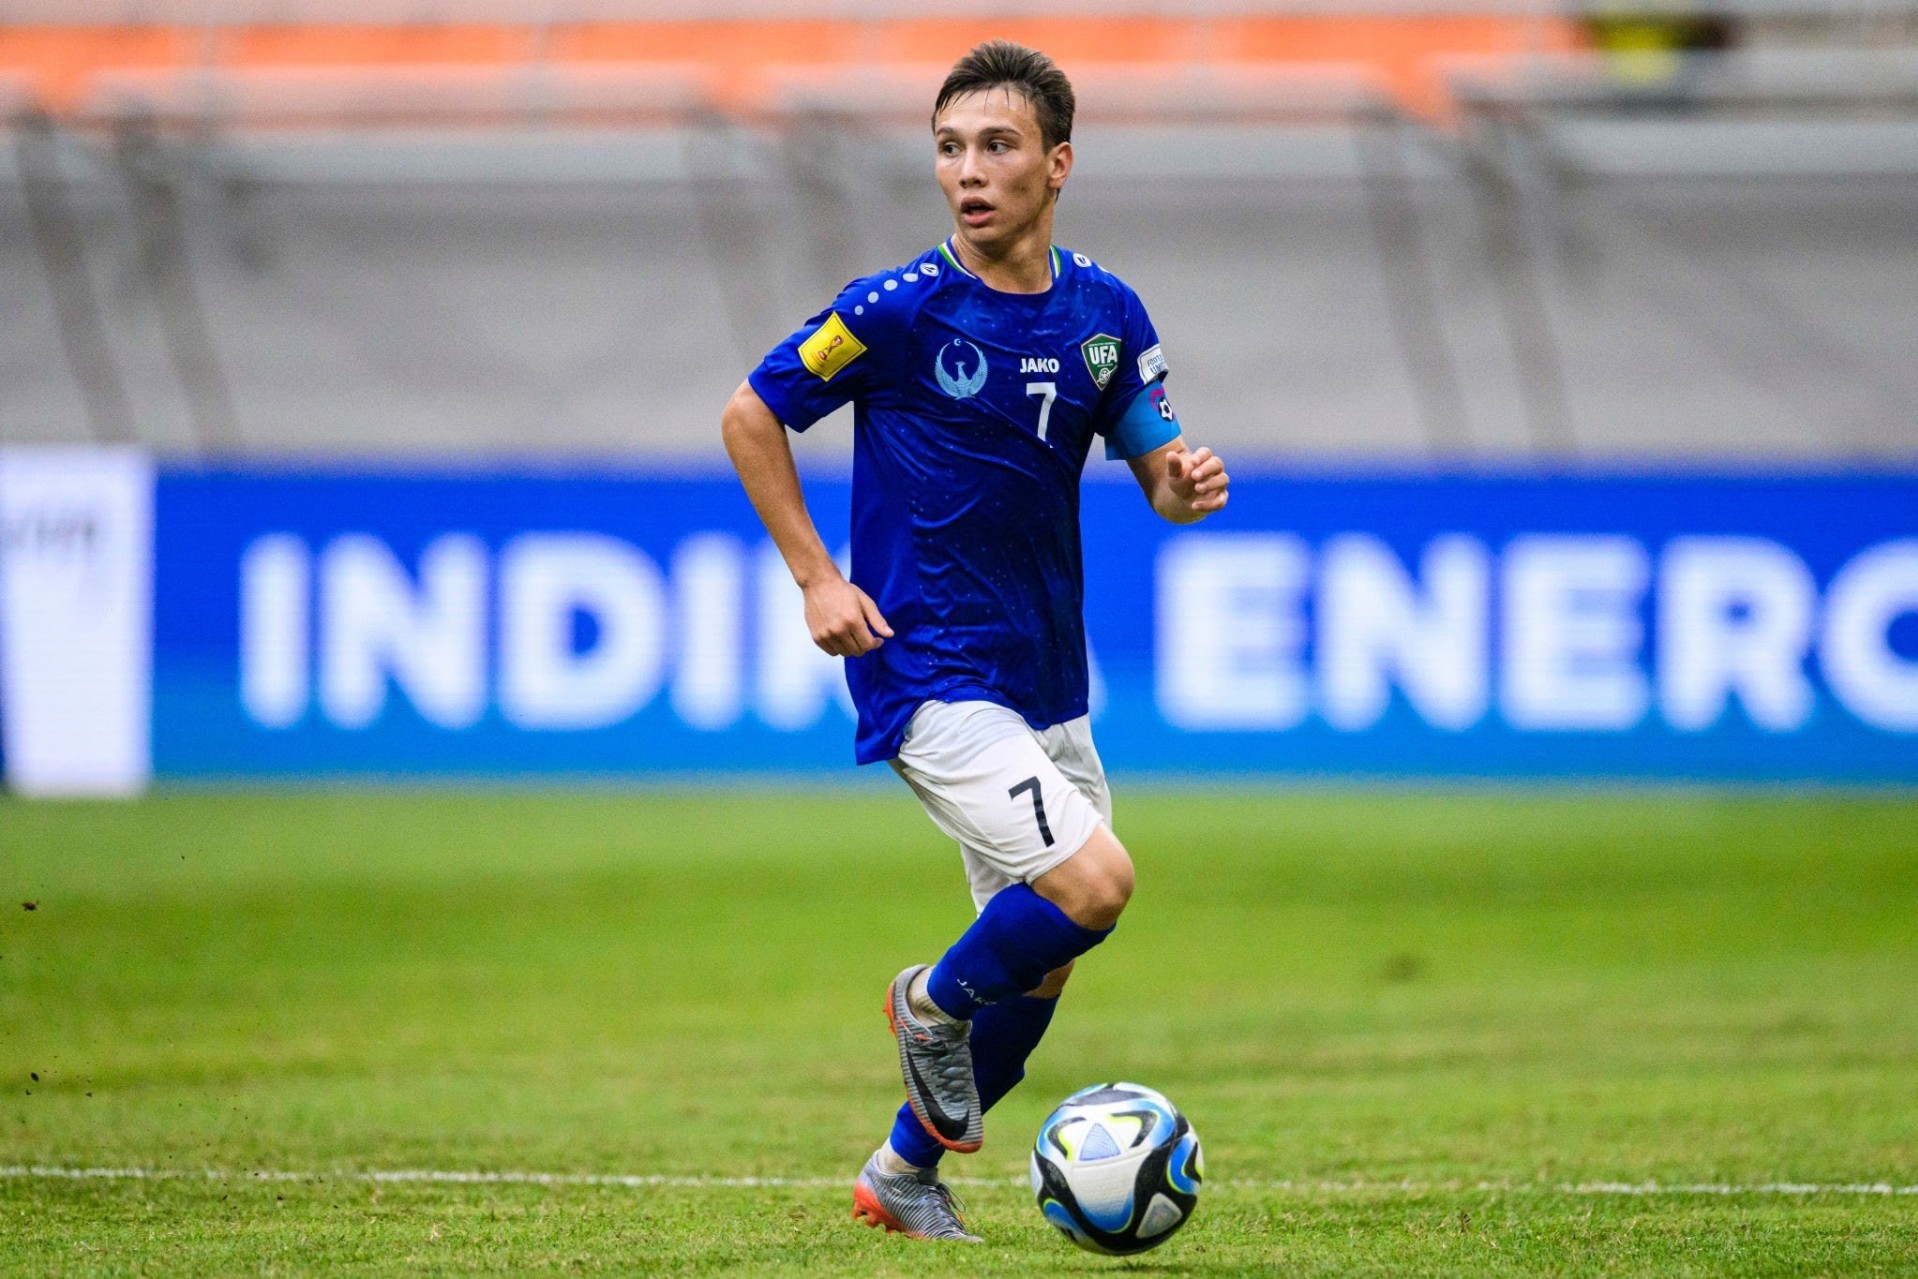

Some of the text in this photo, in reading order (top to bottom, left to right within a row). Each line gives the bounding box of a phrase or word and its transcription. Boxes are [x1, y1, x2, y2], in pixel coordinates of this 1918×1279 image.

[1020, 357, 1060, 373] JAKO
[1087, 344, 1118, 365] UFA
[1026, 381, 1057, 448] 7
[1008, 775, 1055, 848] 7
